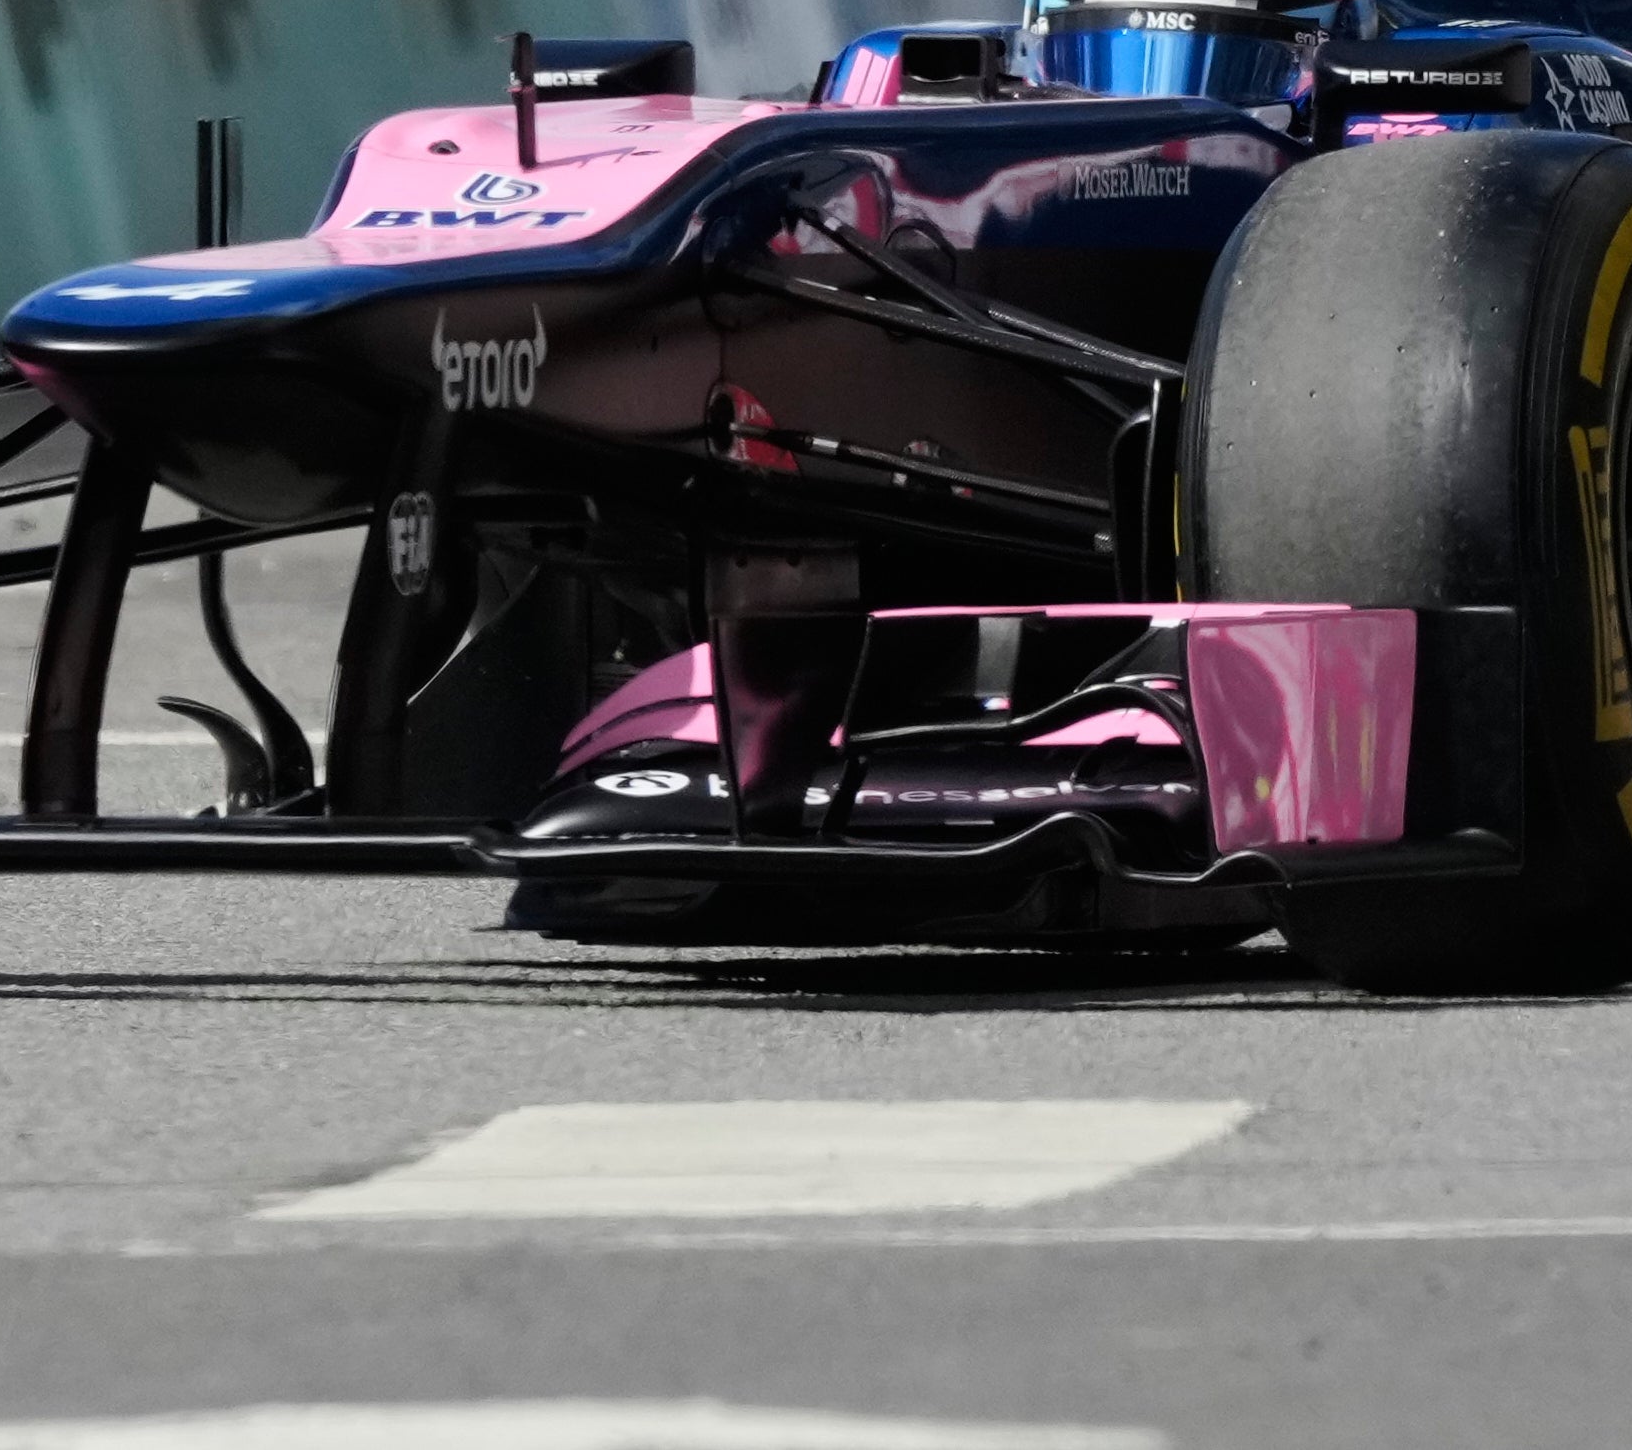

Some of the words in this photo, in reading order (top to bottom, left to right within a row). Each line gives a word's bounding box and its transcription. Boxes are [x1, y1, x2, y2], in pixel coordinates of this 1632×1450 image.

[1146, 10, 1198, 32] MSC
[1562, 53, 1611, 87] MODO
[1579, 89, 1630, 125] CASINO
[350, 209, 588, 230] BWT
